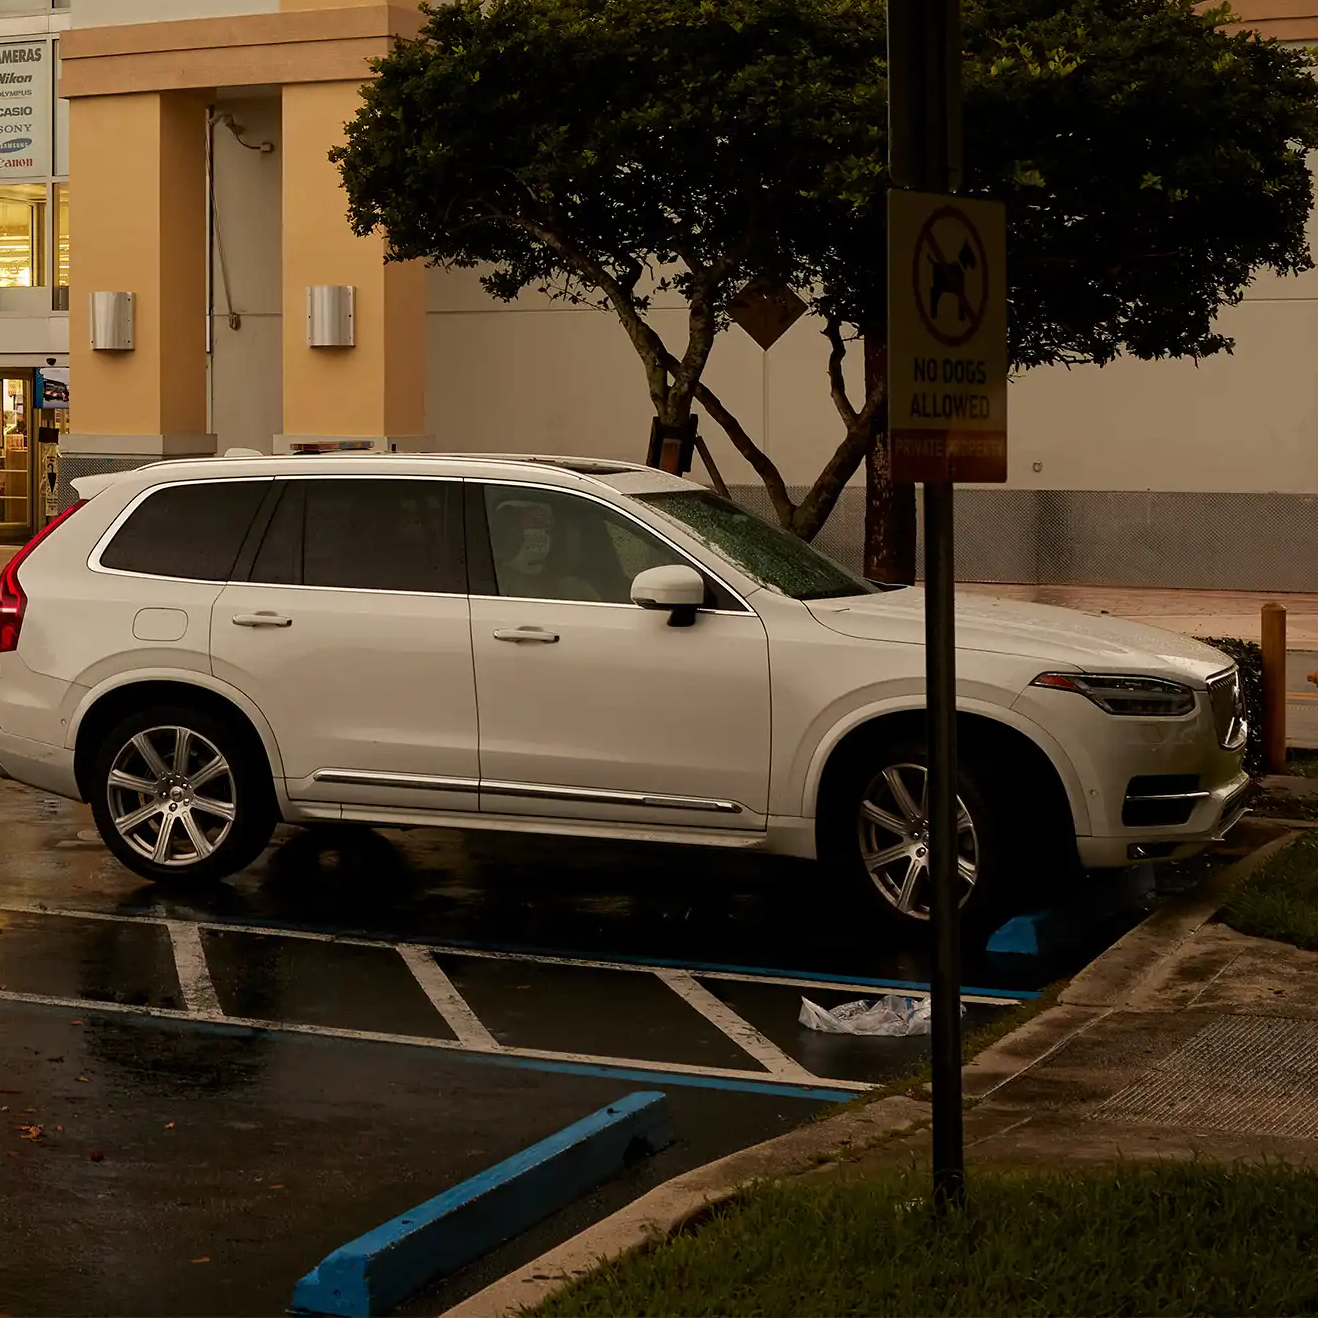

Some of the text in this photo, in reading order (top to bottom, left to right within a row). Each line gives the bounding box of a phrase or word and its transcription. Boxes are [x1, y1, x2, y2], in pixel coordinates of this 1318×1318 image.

[914, 357, 987, 384] NO DOGS
[910, 392, 989, 420] ALLOWED
[895, 437, 1006, 458] PRIVATE PROPERTY
